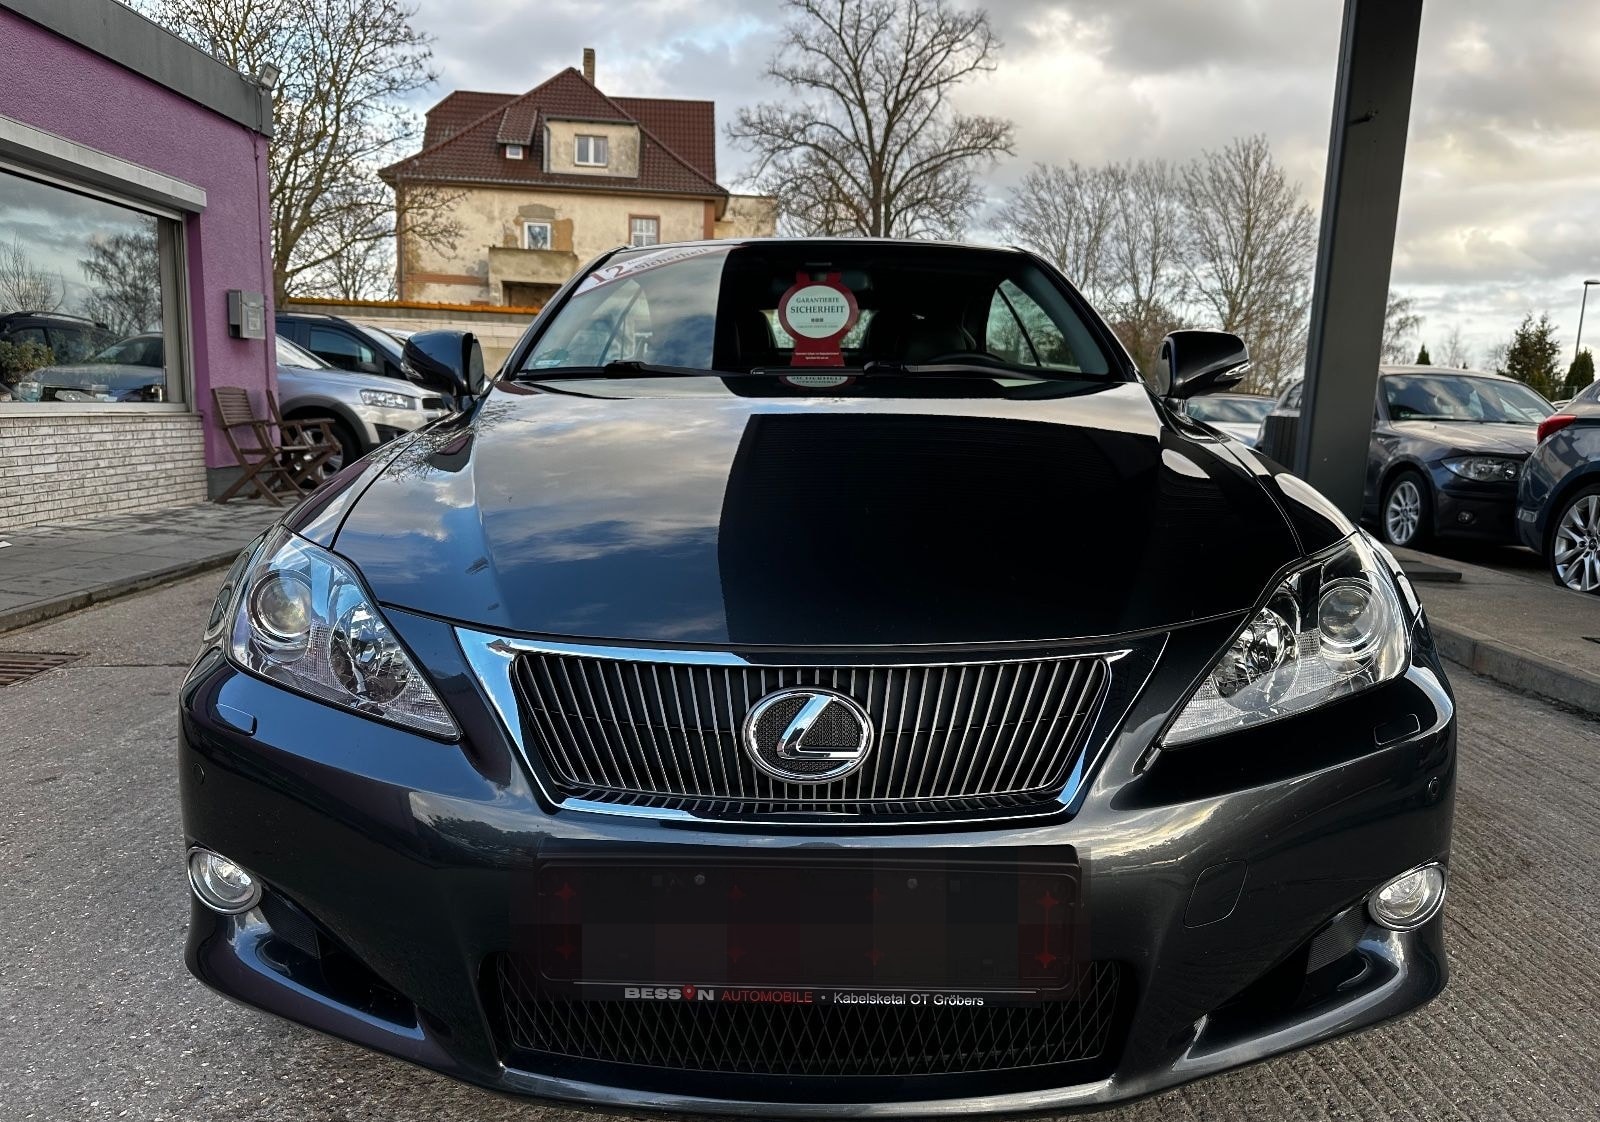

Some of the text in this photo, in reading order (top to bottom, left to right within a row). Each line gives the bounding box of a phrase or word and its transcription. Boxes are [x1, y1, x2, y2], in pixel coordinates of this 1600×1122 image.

[790, 305, 846, 314] SICHERHEIT
[722, 991, 813, 1003] AUTOMOBILE
[833, 992, 906, 1006] Kabelsketal
[910, 994, 930, 1006] OT
[933, 995, 985, 1007] Gröbers
